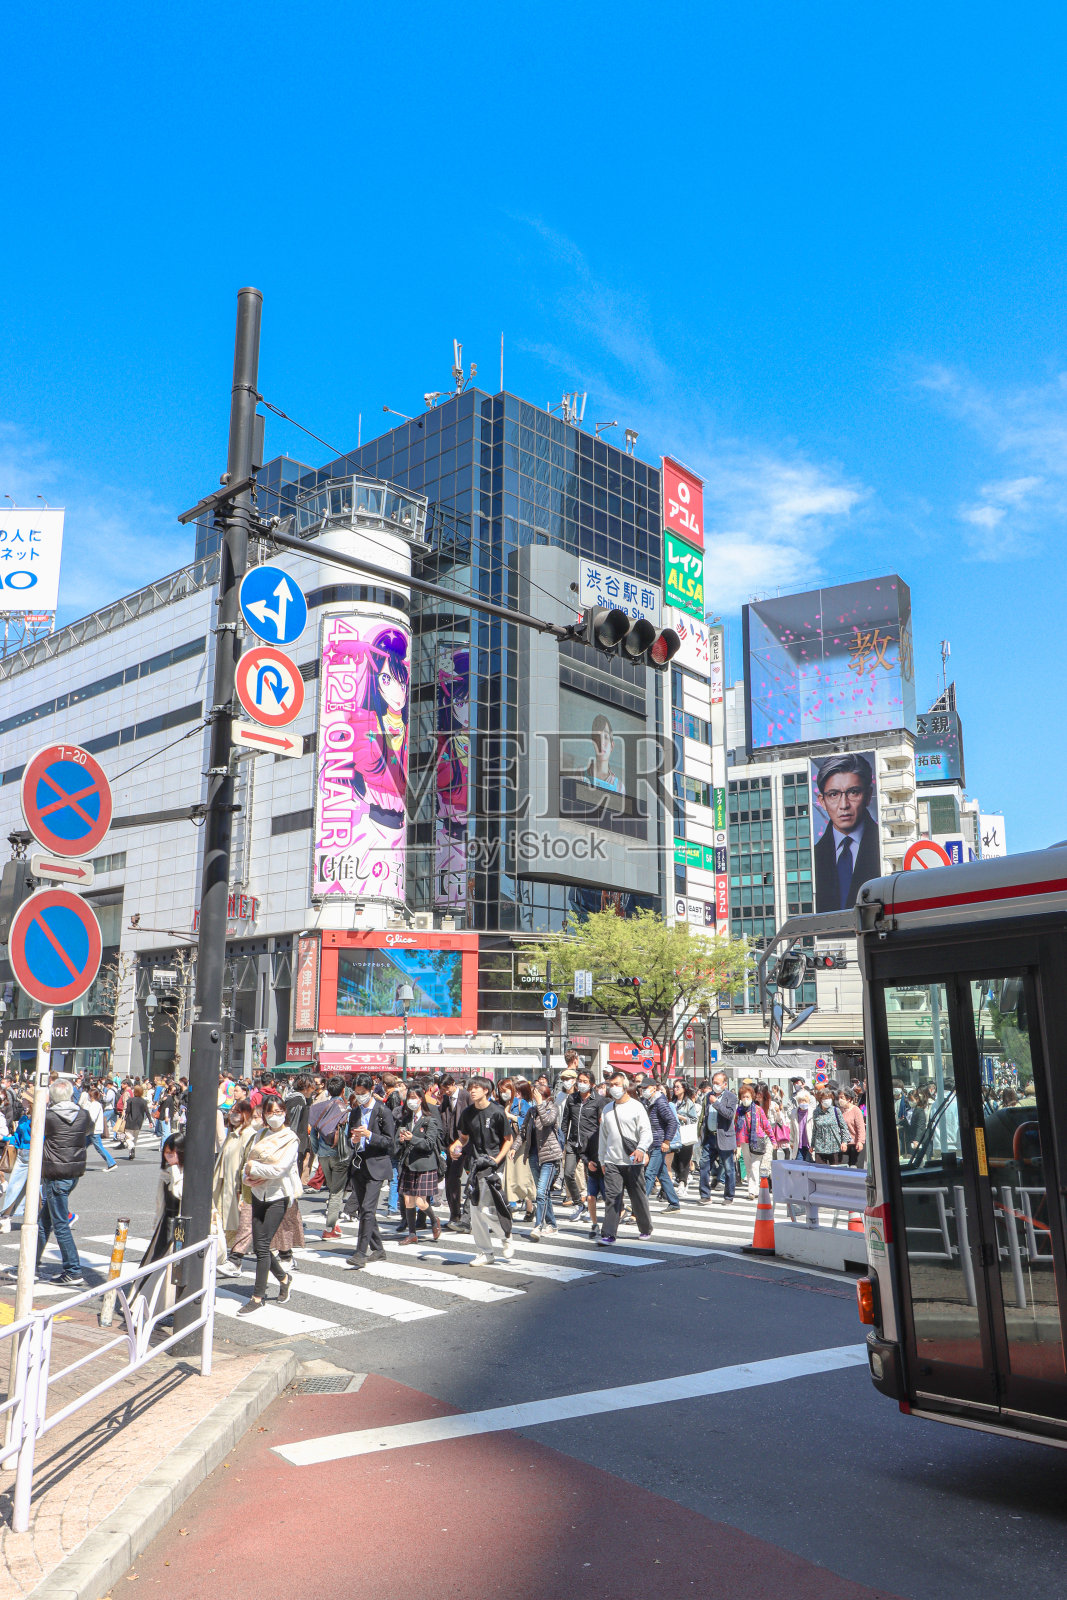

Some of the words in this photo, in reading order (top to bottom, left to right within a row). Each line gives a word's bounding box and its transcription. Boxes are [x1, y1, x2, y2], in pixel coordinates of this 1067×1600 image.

[668, 498, 700, 535] アコム
[668, 541, 703, 578] レイク
[0, 570, 38, 590] O
[586, 567, 655, 610] 渋谷駅前
[667, 567, 704, 604] ALSA
[57, 746, 88, 765] 7-20
[193, 893, 259, 931] MNET
[385, 933, 417, 947] Glico
[300, 951, 313, 1026] 天津甘栗
[50, 1026, 69, 1037] AGLE
[915, 1015, 932, 1026] JR
